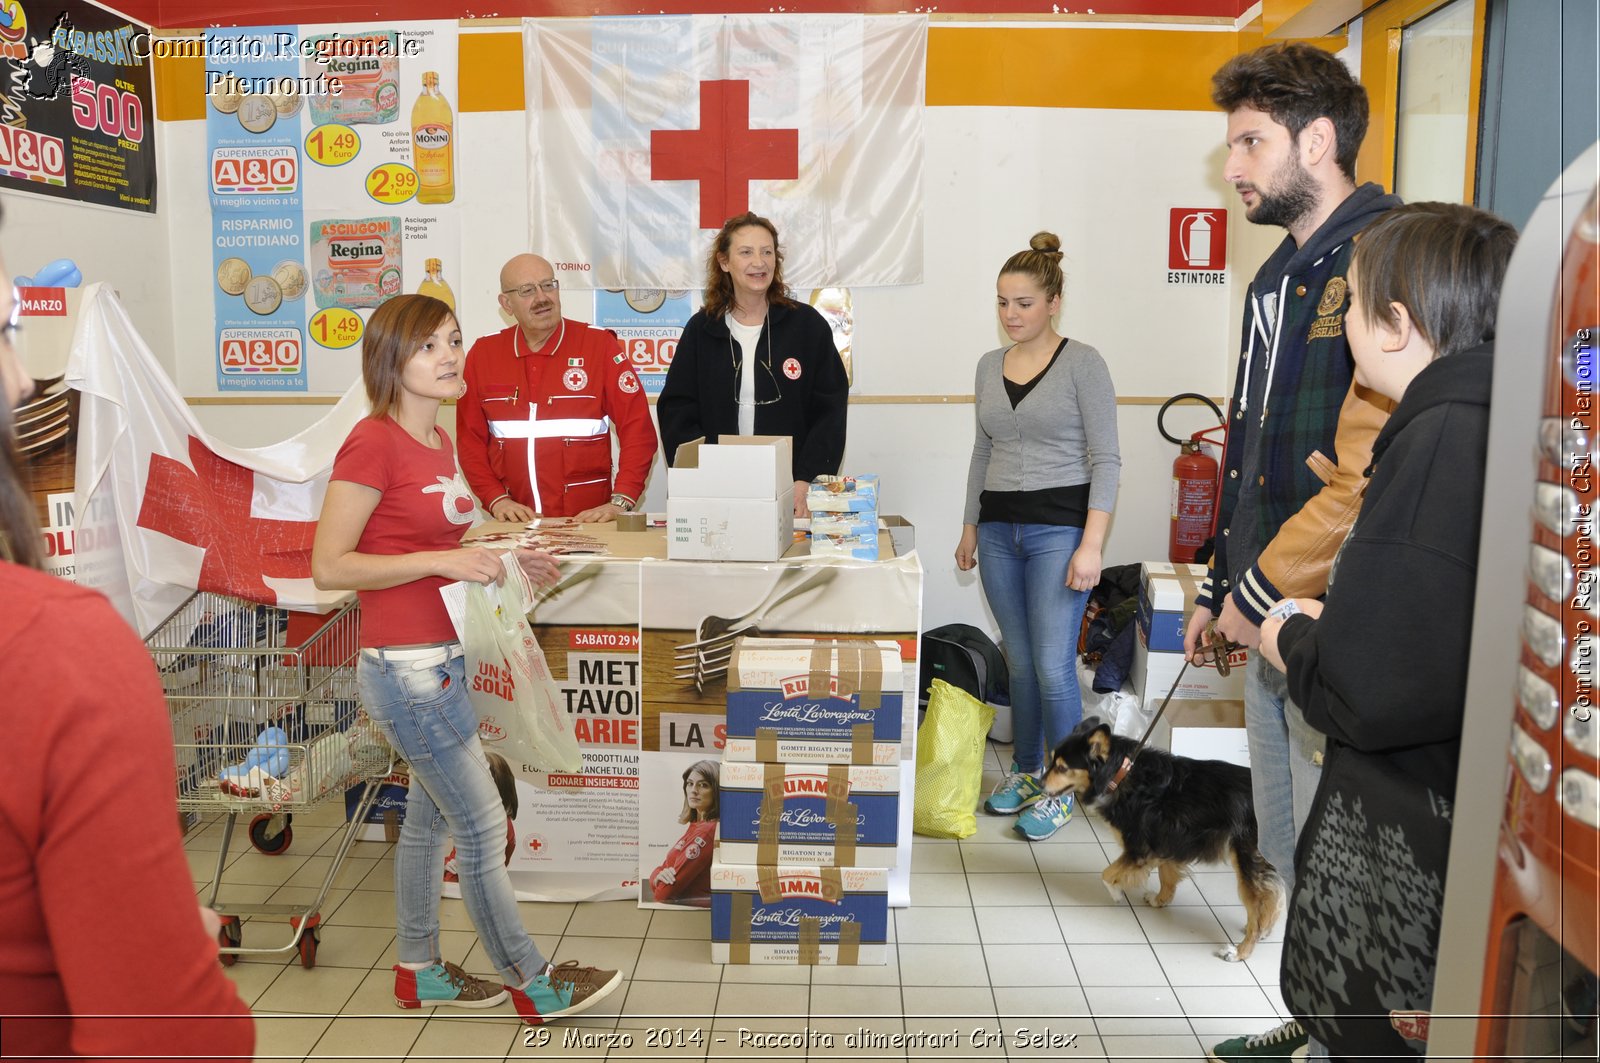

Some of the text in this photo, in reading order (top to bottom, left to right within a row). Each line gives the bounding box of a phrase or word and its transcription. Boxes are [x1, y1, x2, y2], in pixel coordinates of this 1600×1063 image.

[115, 80, 135, 93] OLTRE
[70, 73, 143, 143] 500
[118, 138, 139, 152] PREZZI
[310, 131, 355, 160] 1,49
[416, 134, 448, 144] MONINI
[217, 149, 288, 158] SUPERMERCATI
[216, 160, 293, 184] A&O
[372, 169, 416, 197] 2,99
[220, 197, 251, 208] meglio
[253, 196, 280, 207] vicino
[282, 198, 288, 206] a
[289, 197, 299, 206] te
[221, 218, 293, 232] RISPARMIO
[404, 216, 437, 224] Asciugoni
[320, 222, 391, 235] ASCIUGONI
[216, 234, 300, 248] QUOTIDIANO
[330, 242, 383, 259] Regina
[555, 262, 591, 271] TORINO
[1168, 271, 1225, 284] ESTINTORE
[21, 300, 63, 312] MARZO
[224, 330, 293, 338] SUPERMERCATI
[314, 314, 359, 342] 1,49
[616, 329, 677, 337] PERMERCATI
[223, 341, 298, 364] A&O
[226, 377, 256, 388] meglio
[258, 376, 285, 386] vicino
[287, 378, 293, 386] a
[294, 377, 304, 386] te
[575, 634, 616, 646] SABATO
[618, 635, 630, 646] 29
[579, 660, 639, 686] MET
[759, 702, 800, 722] Lenta
[575, 718, 639, 746] ARIE
[670, 722, 705, 748] LA
[582, 753, 622, 763] PRODOTTI
[585, 766, 610, 775] ANCHE
[612, 767, 624, 776] TU.
[550, 776, 584, 787] DONARE
[585, 777, 618, 788] INSIEME
[783, 849, 816, 857] RIGATONI
